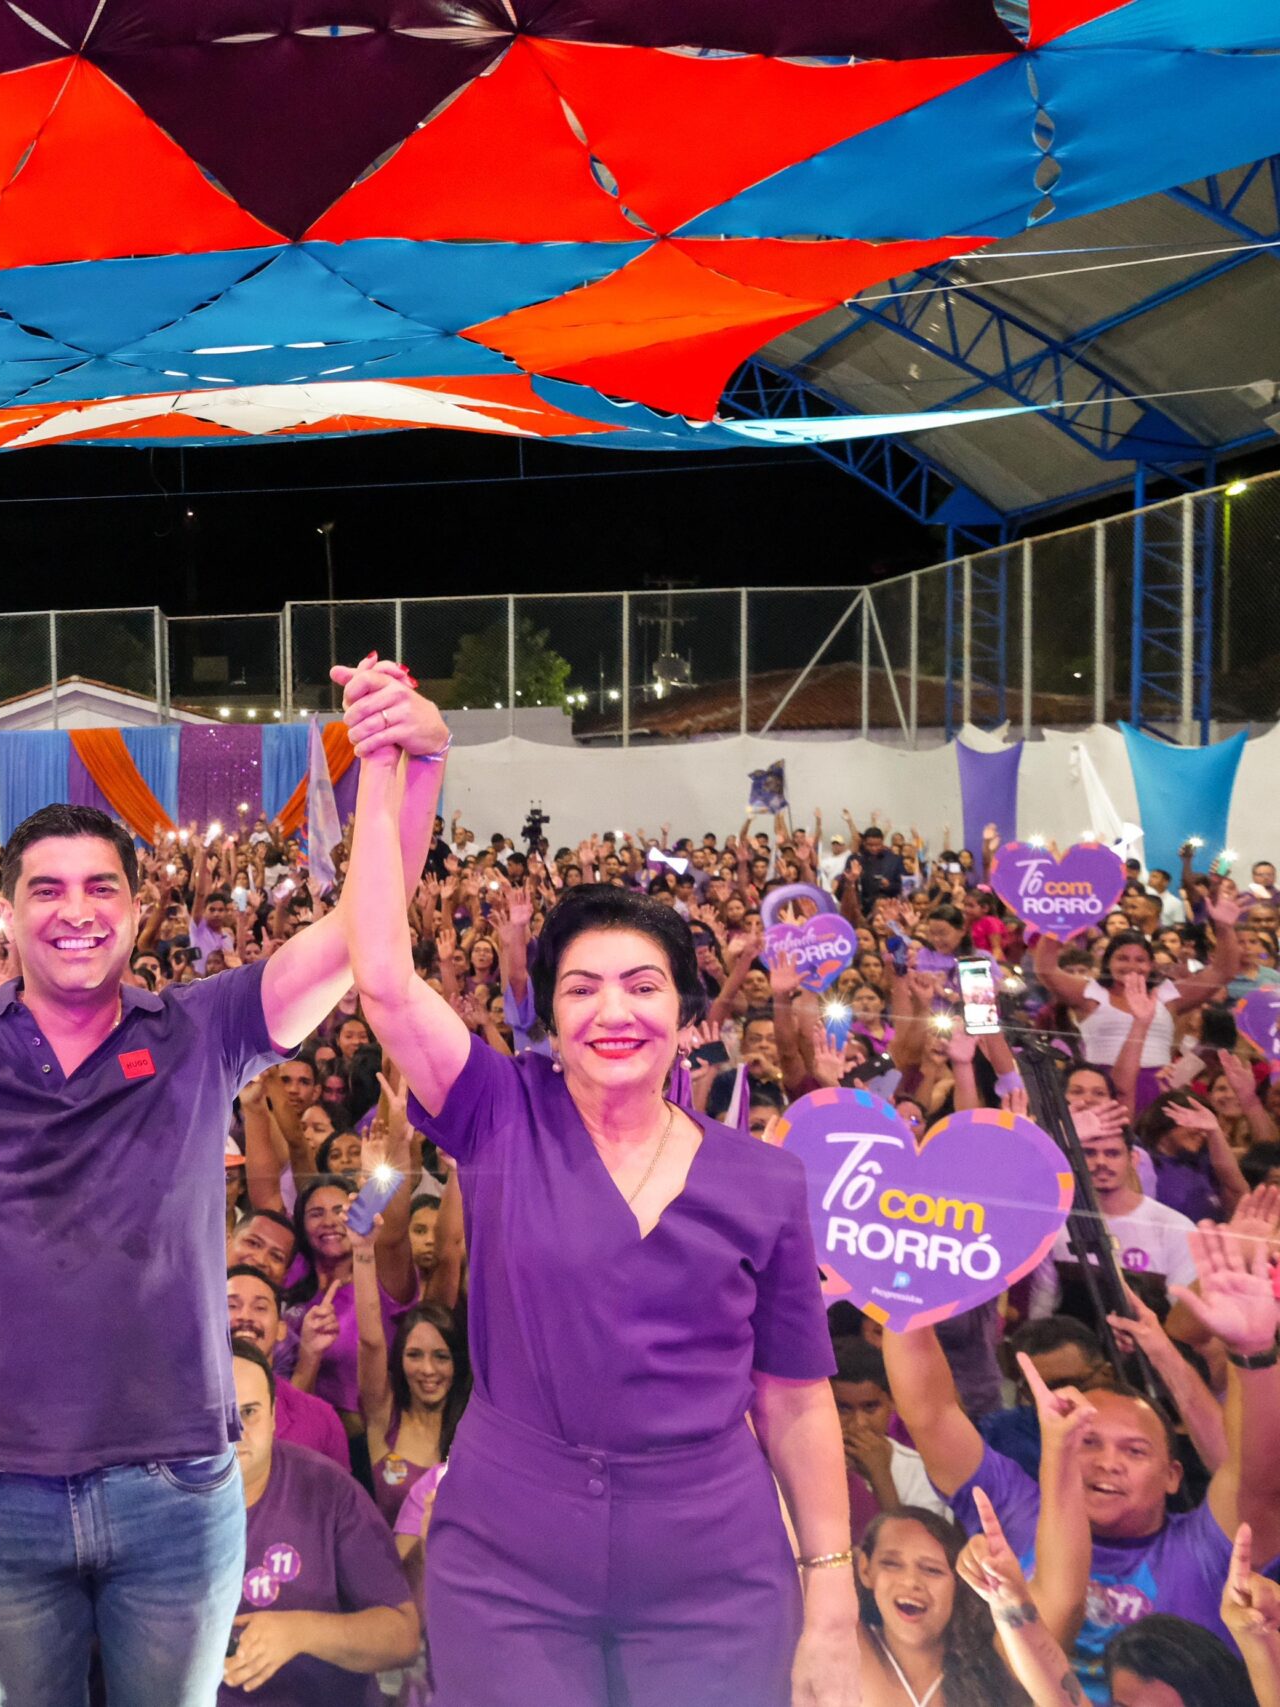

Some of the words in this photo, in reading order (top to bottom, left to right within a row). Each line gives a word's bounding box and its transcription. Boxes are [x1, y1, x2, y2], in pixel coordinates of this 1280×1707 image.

[1015, 858, 1052, 897] Tô
[1044, 881, 1093, 896] com
[1022, 894, 1103, 915] RORRÓ
[775, 934, 852, 966] ORRÓ
[126, 1059, 148, 1069] HUGO
[822, 1131, 905, 1212] Tô
[878, 1188, 985, 1234] com
[825, 1216, 1002, 1281] RORRÓ
[270, 1551, 293, 1575] 11
[249, 1575, 270, 1599] 11
[1107, 1588, 1142, 1621] 11
